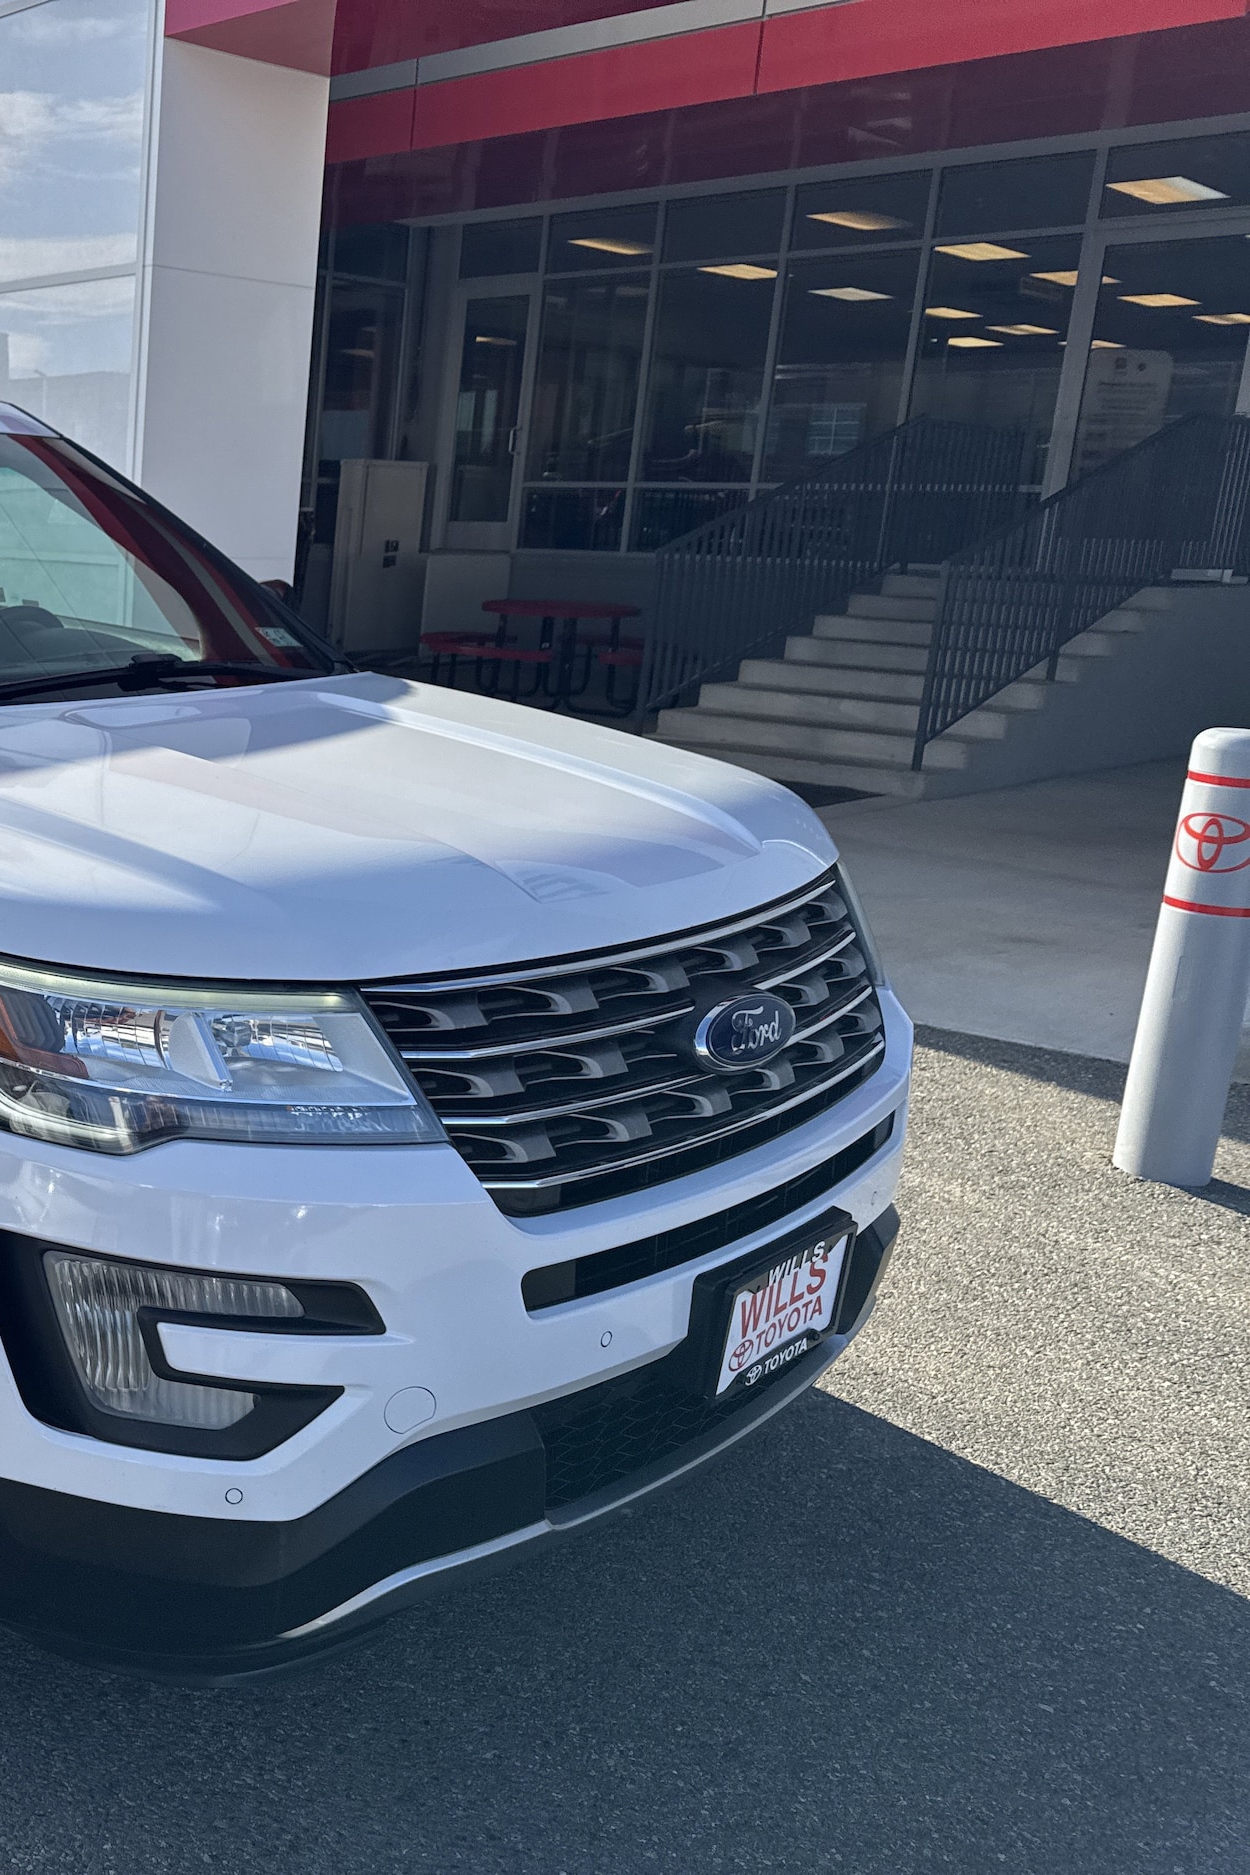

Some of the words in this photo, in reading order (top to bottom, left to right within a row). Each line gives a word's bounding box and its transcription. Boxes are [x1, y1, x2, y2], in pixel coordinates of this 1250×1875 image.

[731, 1005, 782, 1055] Ford
[768, 1240, 826, 1287] WILLS
[741, 1253, 829, 1340] WILLS
[755, 1295, 822, 1355] TOYOTA
[762, 1337, 808, 1374] TOYOTA
